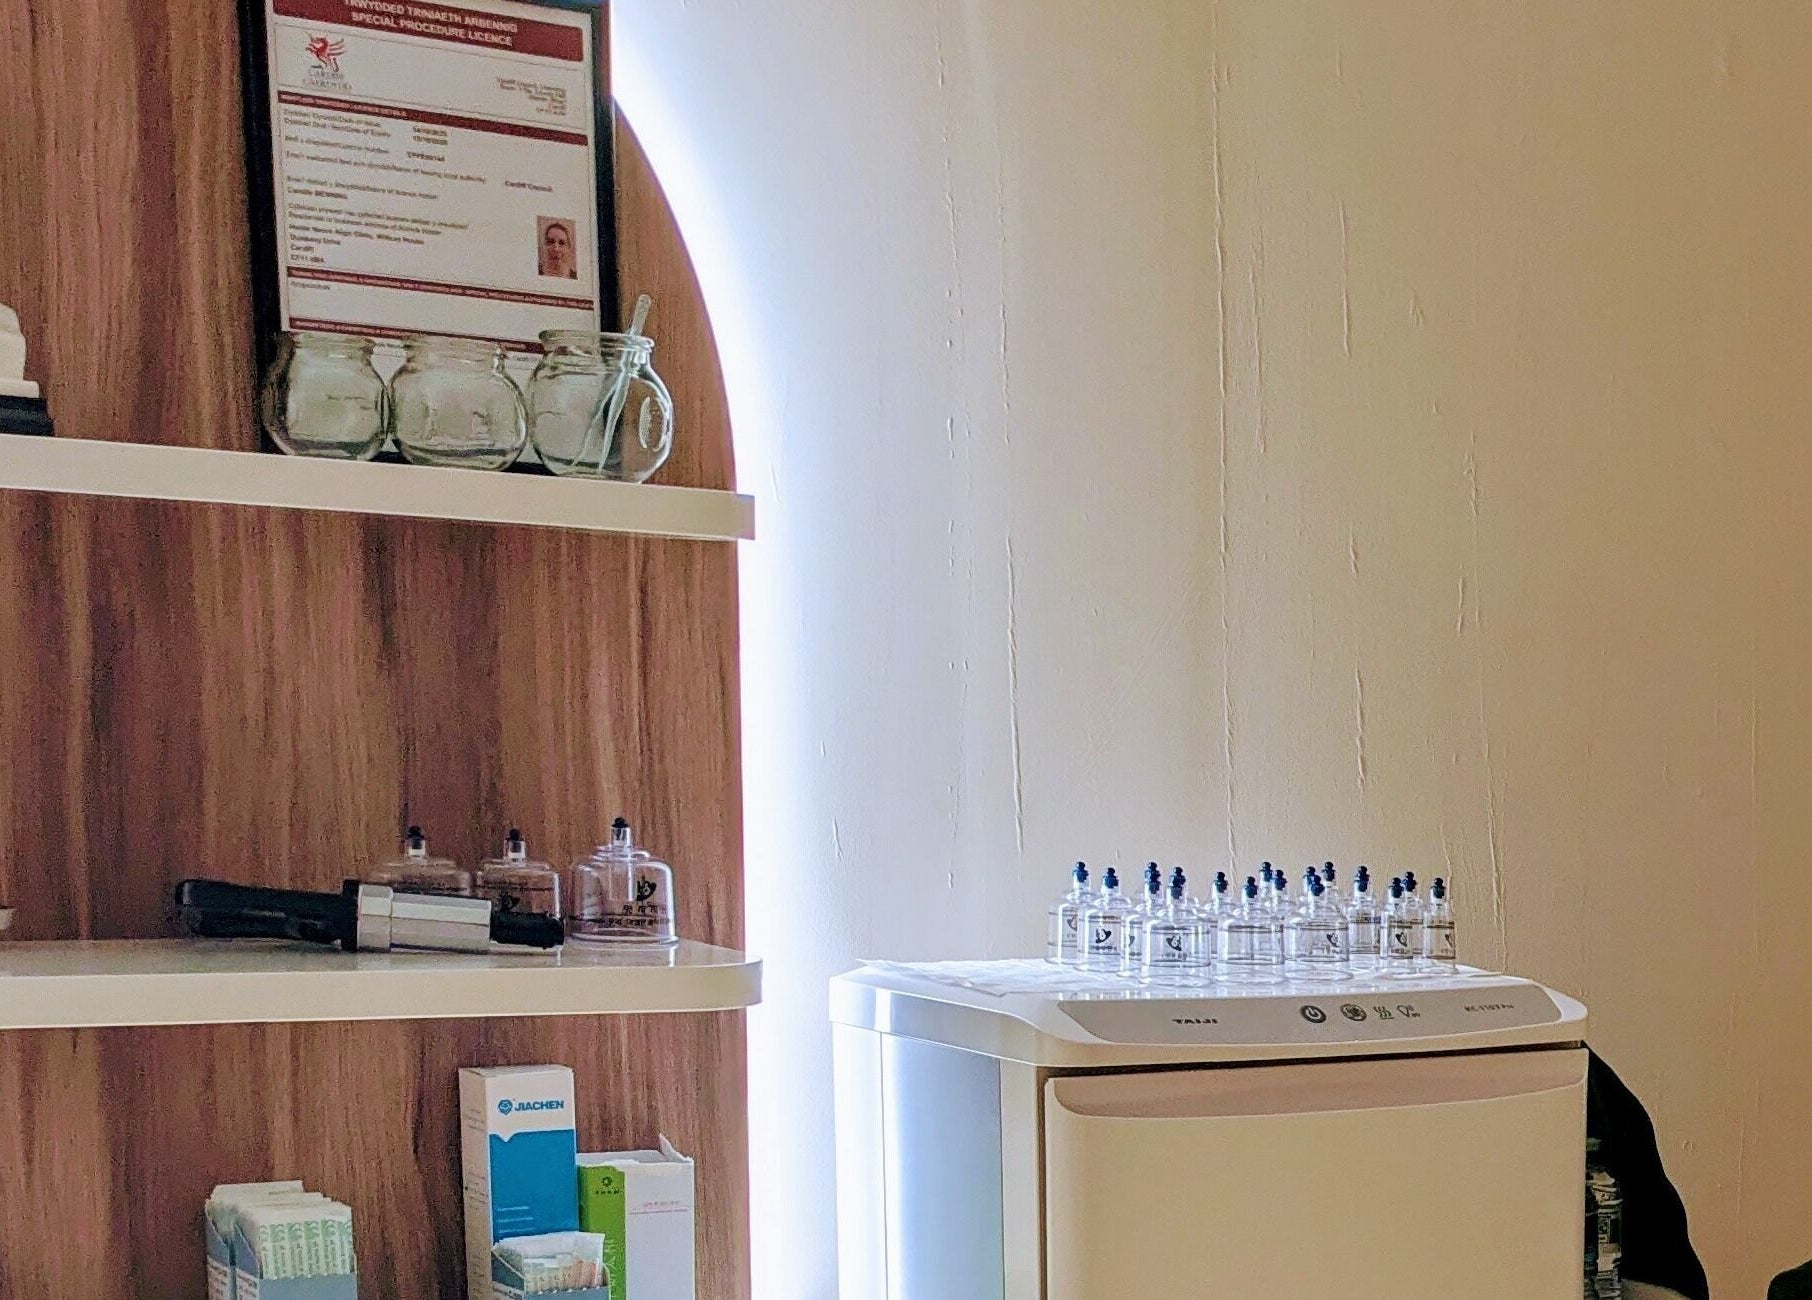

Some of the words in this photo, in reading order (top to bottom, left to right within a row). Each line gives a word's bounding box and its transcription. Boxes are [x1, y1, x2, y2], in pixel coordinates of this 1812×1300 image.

[352, 12, 397, 28] SPECIAL
[400, 20, 465, 39] PROCEDURE
[468, 29, 513, 47] LICENCE
[514, 1100, 565, 1113] JIACHEN
